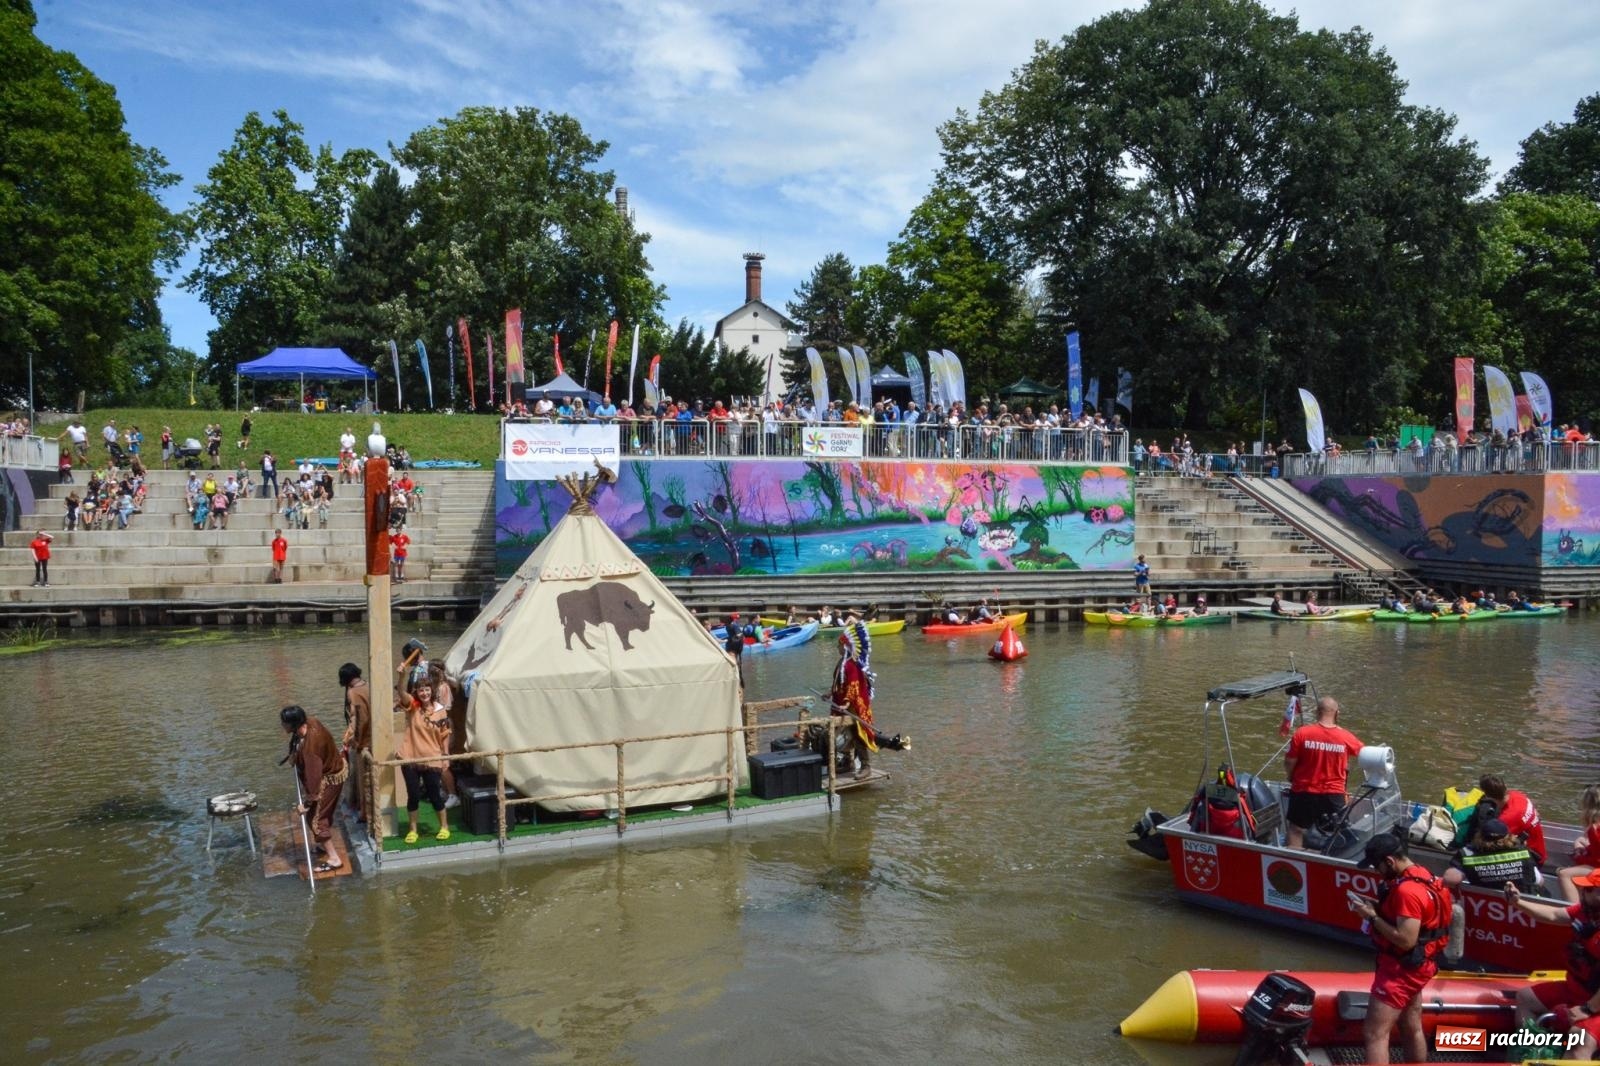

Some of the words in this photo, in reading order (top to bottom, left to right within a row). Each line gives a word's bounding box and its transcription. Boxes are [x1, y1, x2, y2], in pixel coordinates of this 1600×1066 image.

[529, 447, 615, 455] VANESSA
[1184, 839, 1215, 854] NYSA
[1258, 992, 1272, 1003] 15
